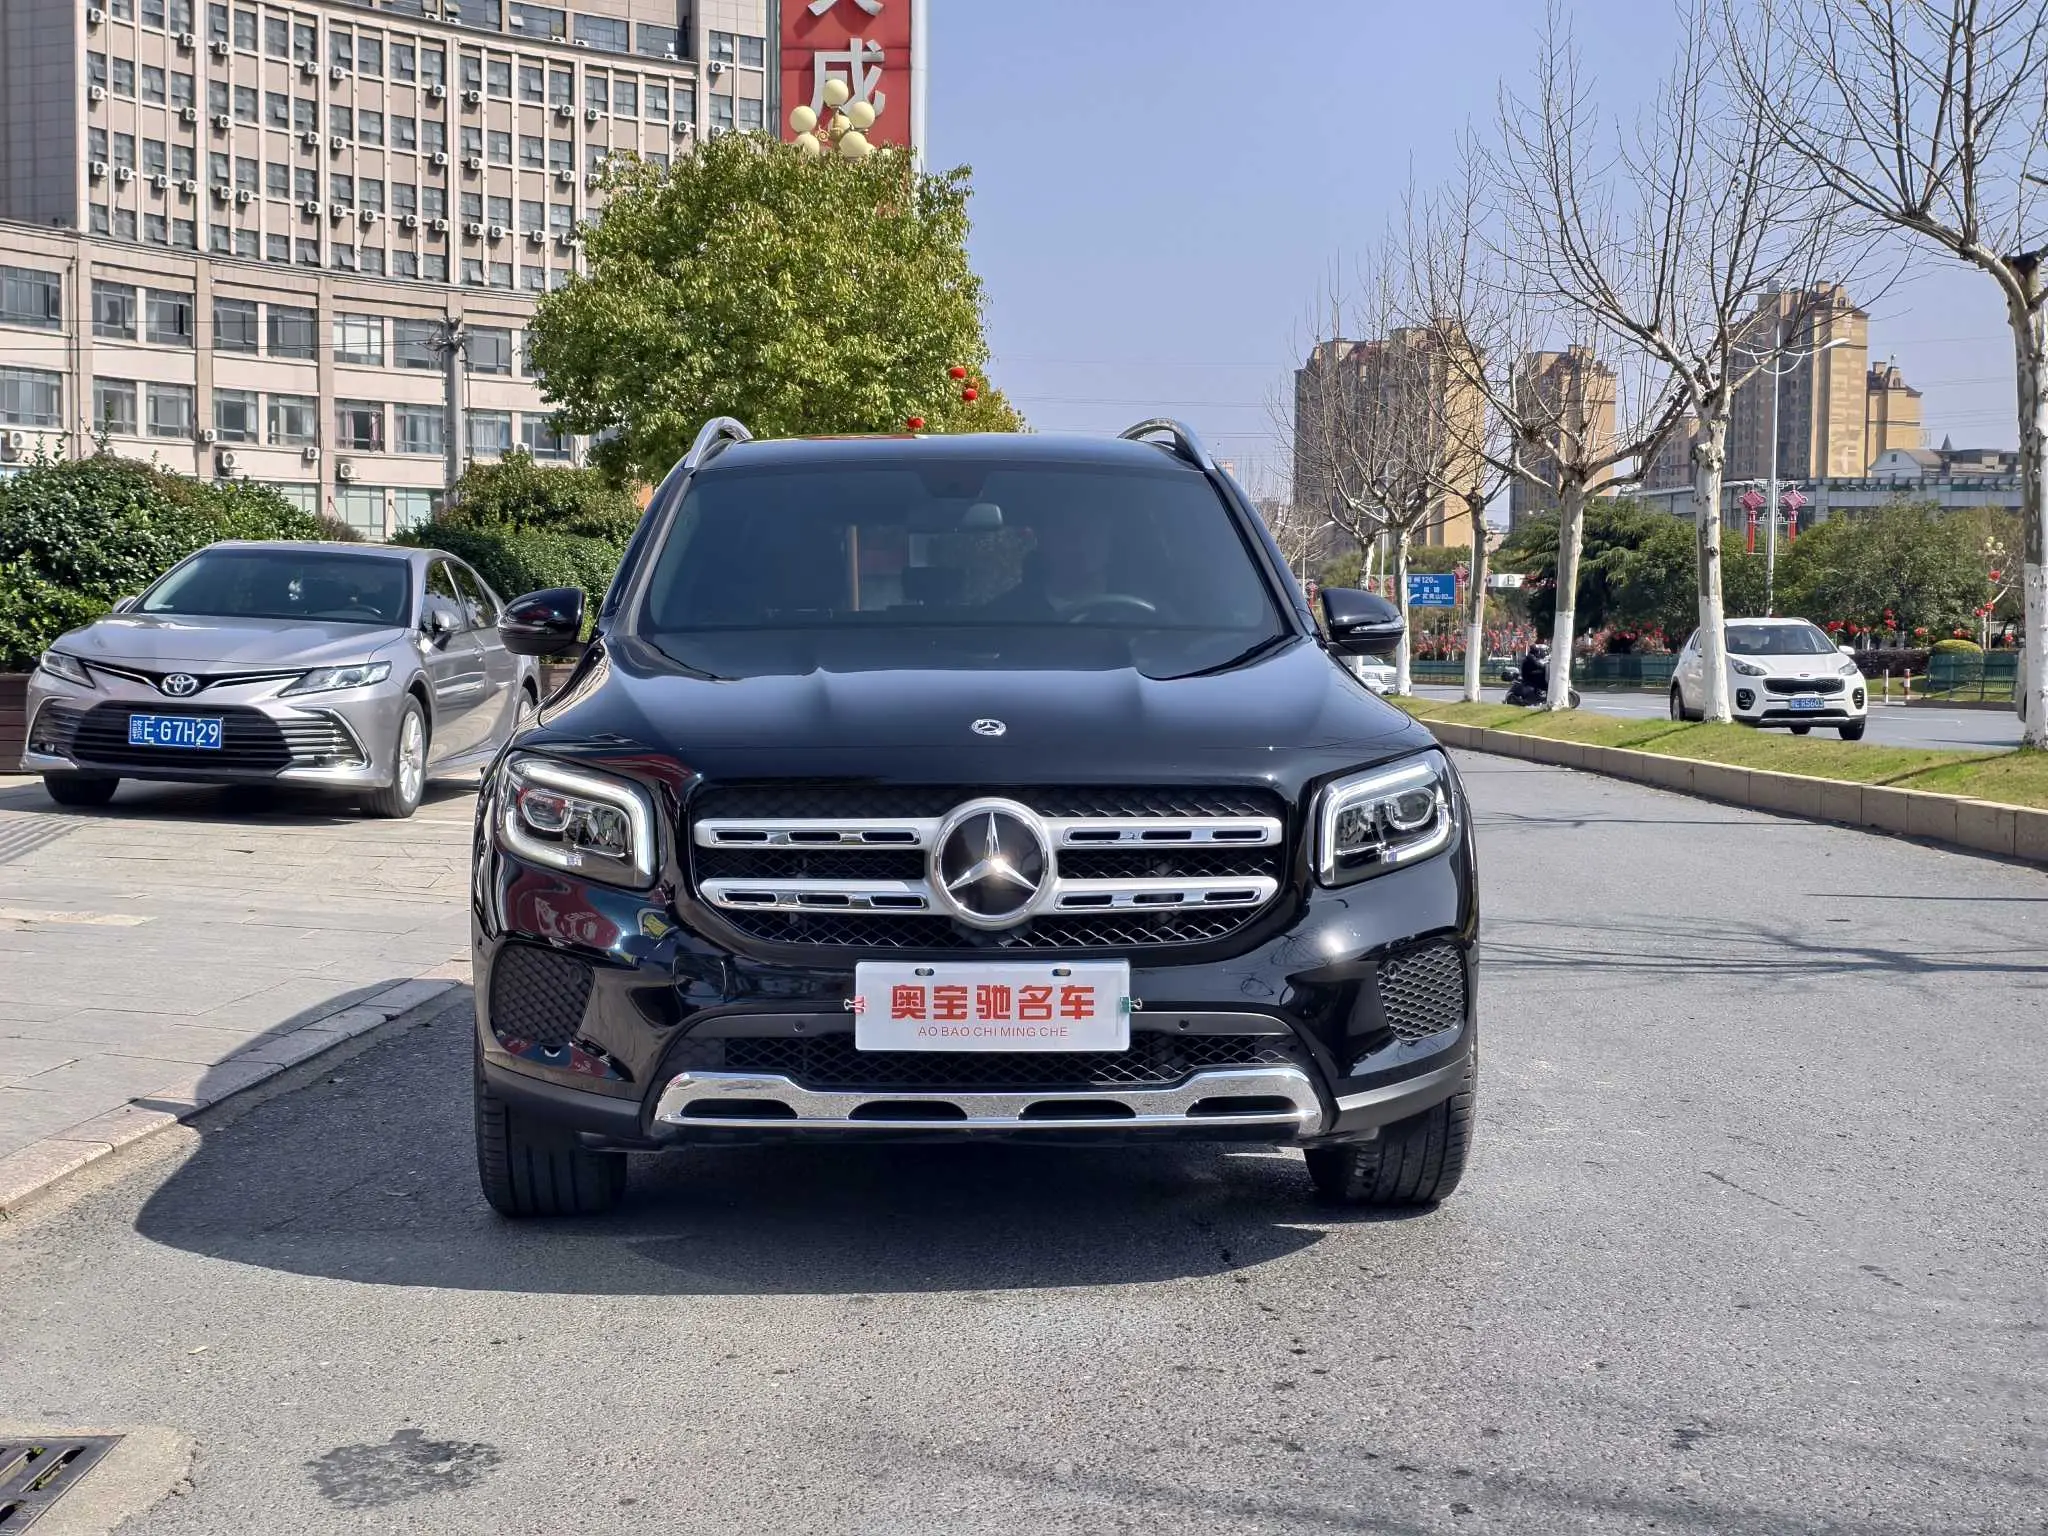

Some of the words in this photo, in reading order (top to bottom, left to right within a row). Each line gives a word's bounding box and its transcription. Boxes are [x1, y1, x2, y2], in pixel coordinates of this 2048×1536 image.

[891, 984, 1095, 1020] 奥宝驰名车
[918, 1026, 938, 1037] AO
[941, 1026, 970, 1037] BAO
[973, 1026, 996, 1037] CHI
[1000, 1026, 1036, 1037] MING
[1039, 1026, 1068, 1037] CHE
